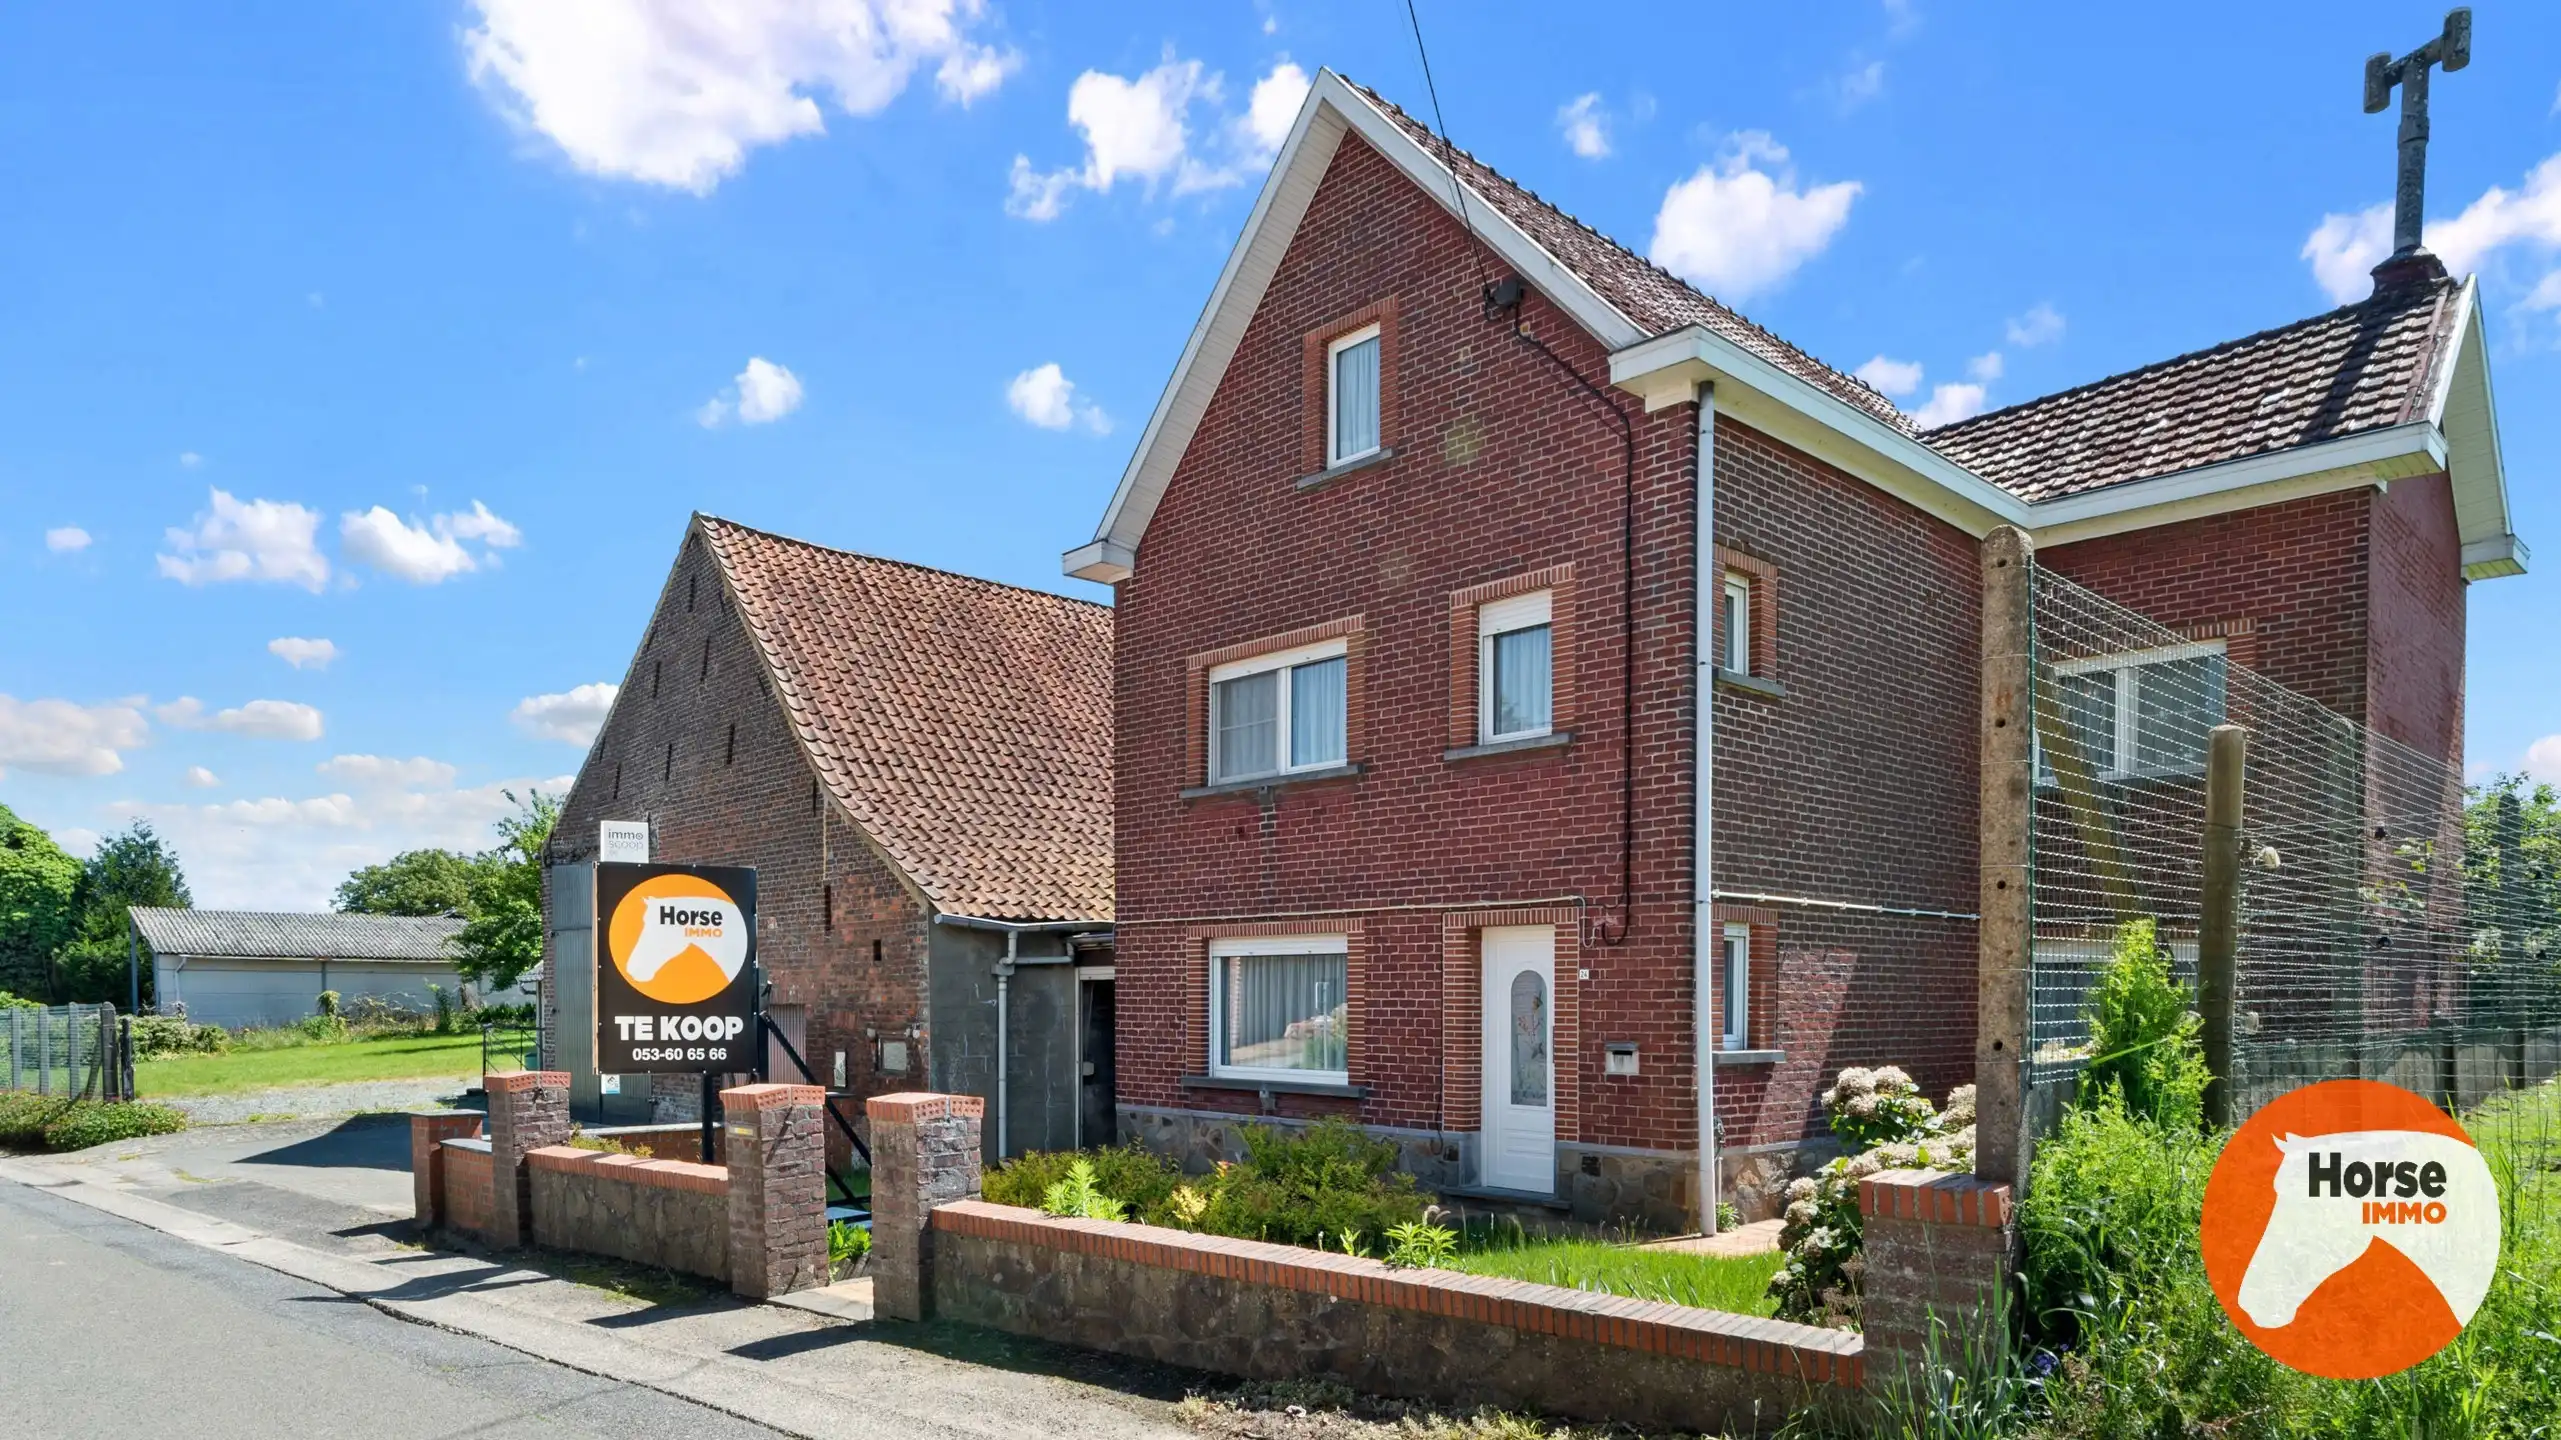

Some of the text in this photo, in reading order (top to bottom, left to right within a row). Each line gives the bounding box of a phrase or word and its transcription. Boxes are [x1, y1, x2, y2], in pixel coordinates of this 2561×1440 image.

[608, 828, 644, 841] immo
[608, 840, 644, 851] scoop
[659, 905, 723, 926] Horse
[684, 927, 723, 938] IMMO
[614, 1016, 744, 1041] TE KOOP
[632, 1048, 727, 1061] 053-60 65 66
